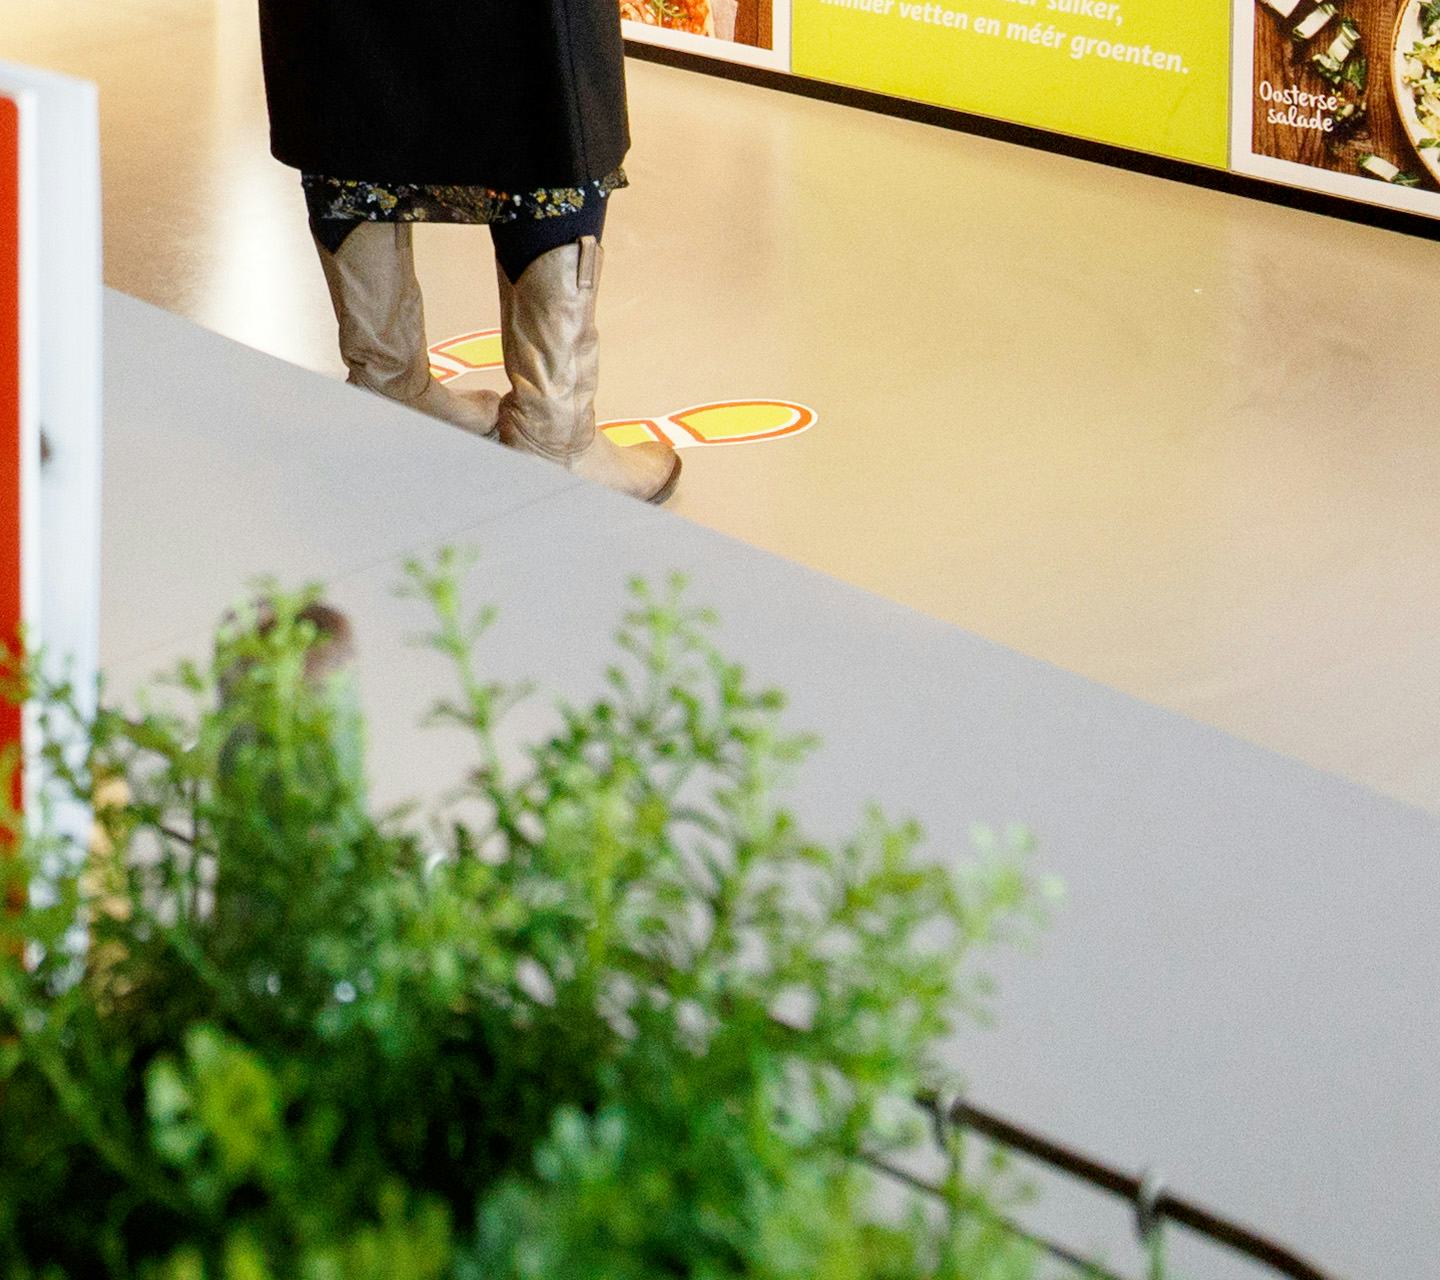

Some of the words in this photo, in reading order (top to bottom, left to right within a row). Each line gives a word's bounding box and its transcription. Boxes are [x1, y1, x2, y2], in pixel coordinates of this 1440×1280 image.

[898, 0, 967, 31] vetten
[973, 14, 1001, 35] en
[1007, 18, 1066, 50] méér
[1070, 33, 1190, 75] groenten.
[1260, 80, 1338, 110] Oosterse
[1267, 105, 1334, 133] salade
